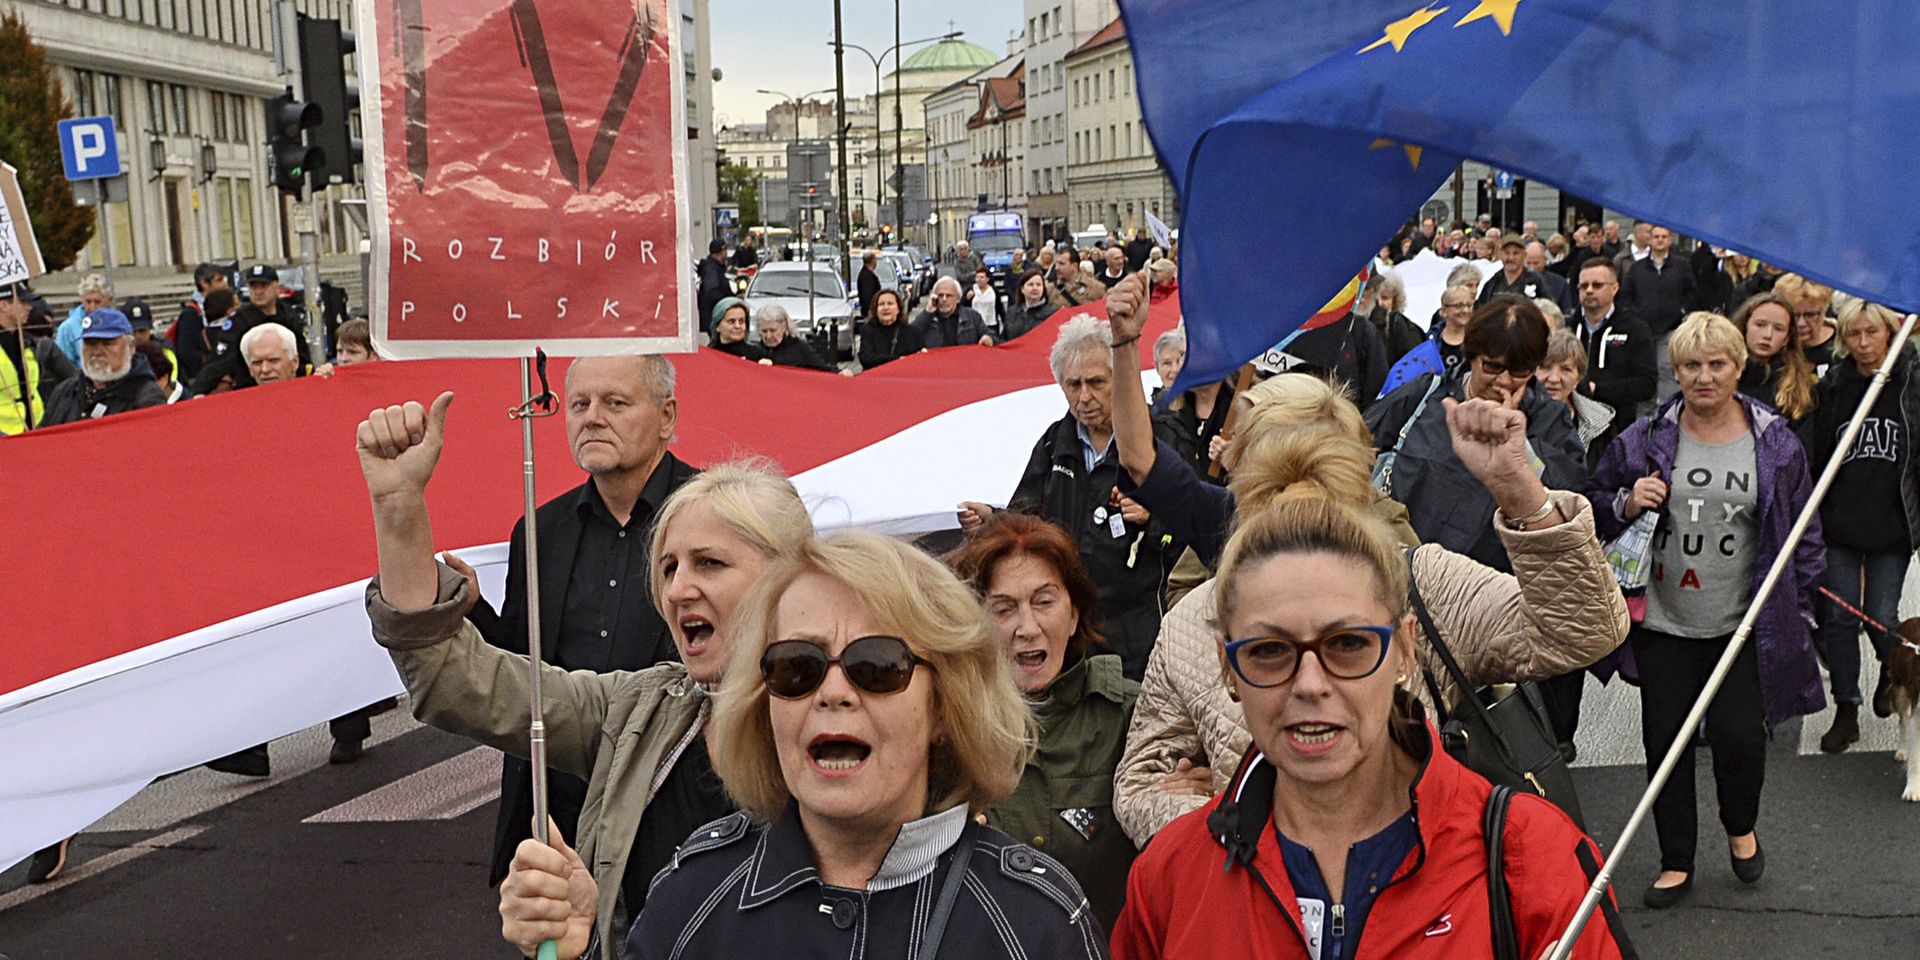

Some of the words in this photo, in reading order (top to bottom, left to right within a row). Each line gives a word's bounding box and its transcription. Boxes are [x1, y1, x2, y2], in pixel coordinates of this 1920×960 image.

[71, 123, 106, 172] P
[402, 230, 657, 265] ROZBIÓR
[1672, 466, 1750, 493] ON
[1687, 498, 1745, 522] TY
[1659, 528, 1735, 557] TUC
[1655, 563, 1701, 590] JA
